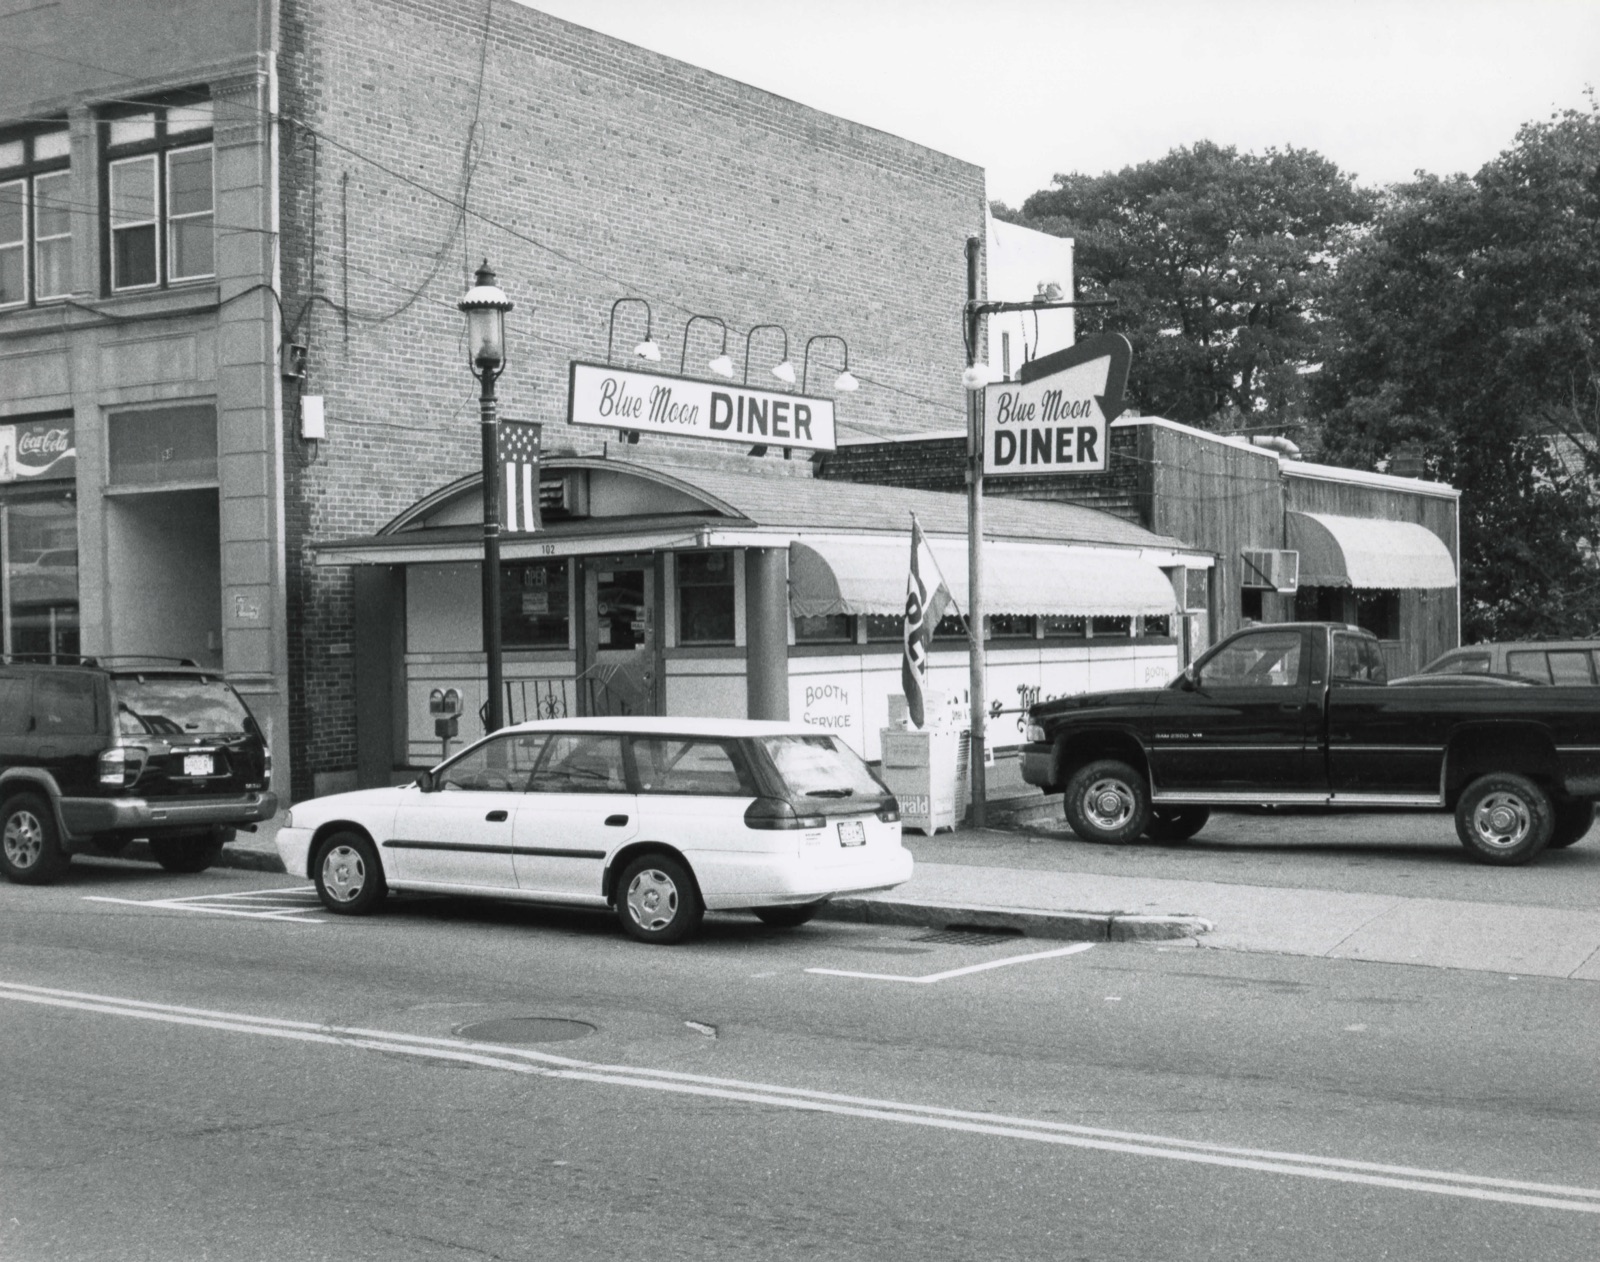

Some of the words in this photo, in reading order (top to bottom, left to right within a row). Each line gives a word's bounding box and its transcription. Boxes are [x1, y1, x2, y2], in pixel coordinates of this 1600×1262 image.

[599, 377, 642, 418] Blue
[648, 385, 699, 425] Moon
[708, 391, 813, 441] DINER
[997, 392, 1036, 424] Blue
[1041, 389, 1092, 422] Moon
[994, 426, 1099, 466] DINER
[542, 545, 555, 554] 102
[524, 569, 547, 586] OPEN
[1145, 666, 1170, 684] BOOTH
[805, 685, 849, 707] BOOTH
[803, 712, 852, 728] SERVICE
